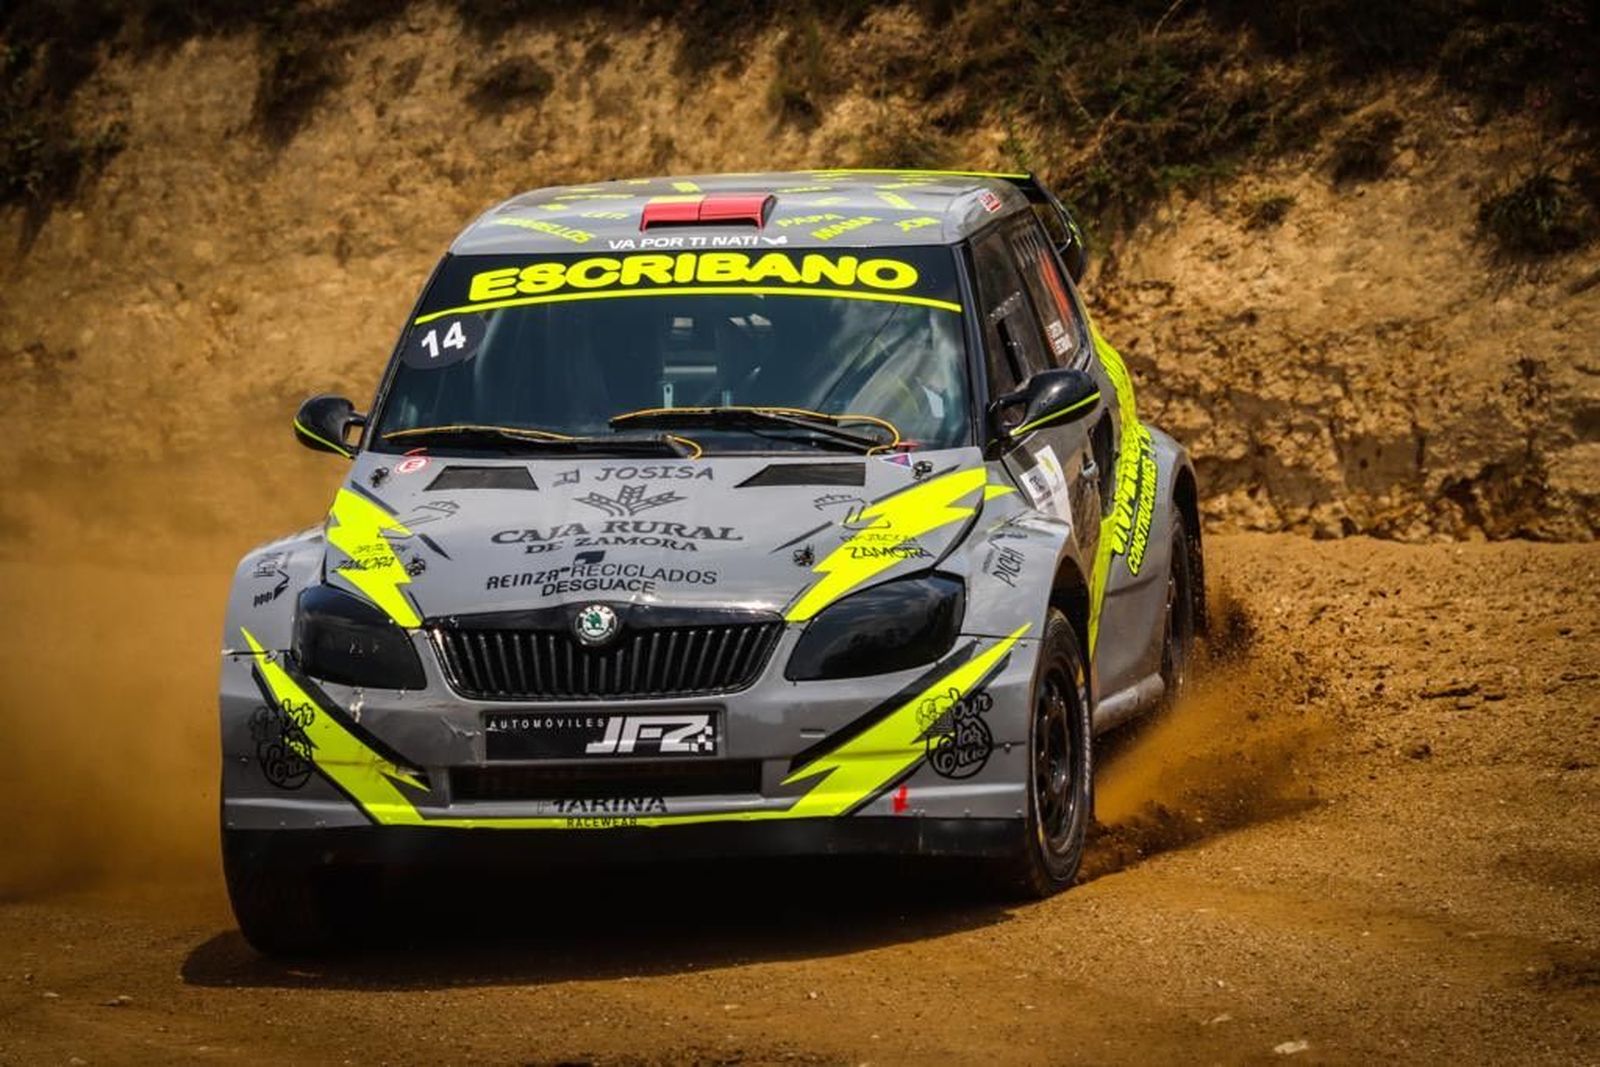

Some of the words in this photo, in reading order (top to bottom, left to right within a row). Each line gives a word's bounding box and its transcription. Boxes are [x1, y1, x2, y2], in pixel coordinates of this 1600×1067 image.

[608, 238, 635, 250] VA
[640, 237, 684, 249] POR
[688, 236, 707, 247] TI
[711, 235, 758, 247] NATI
[468, 252, 919, 302] ESCRIBANO
[421, 321, 466, 358] 14
[594, 465, 715, 482] JOSISA
[490, 521, 591, 545] CAJA
[599, 519, 744, 542] RURAL
[524, 542, 563, 555] DE
[573, 535, 699, 552] ZAMORA
[569, 563, 718, 585] RECICLADOS
[541, 577, 656, 598] DESGUACE
[584, 714, 711, 754] JFZ
[566, 816, 638, 829] RACEWEAR
